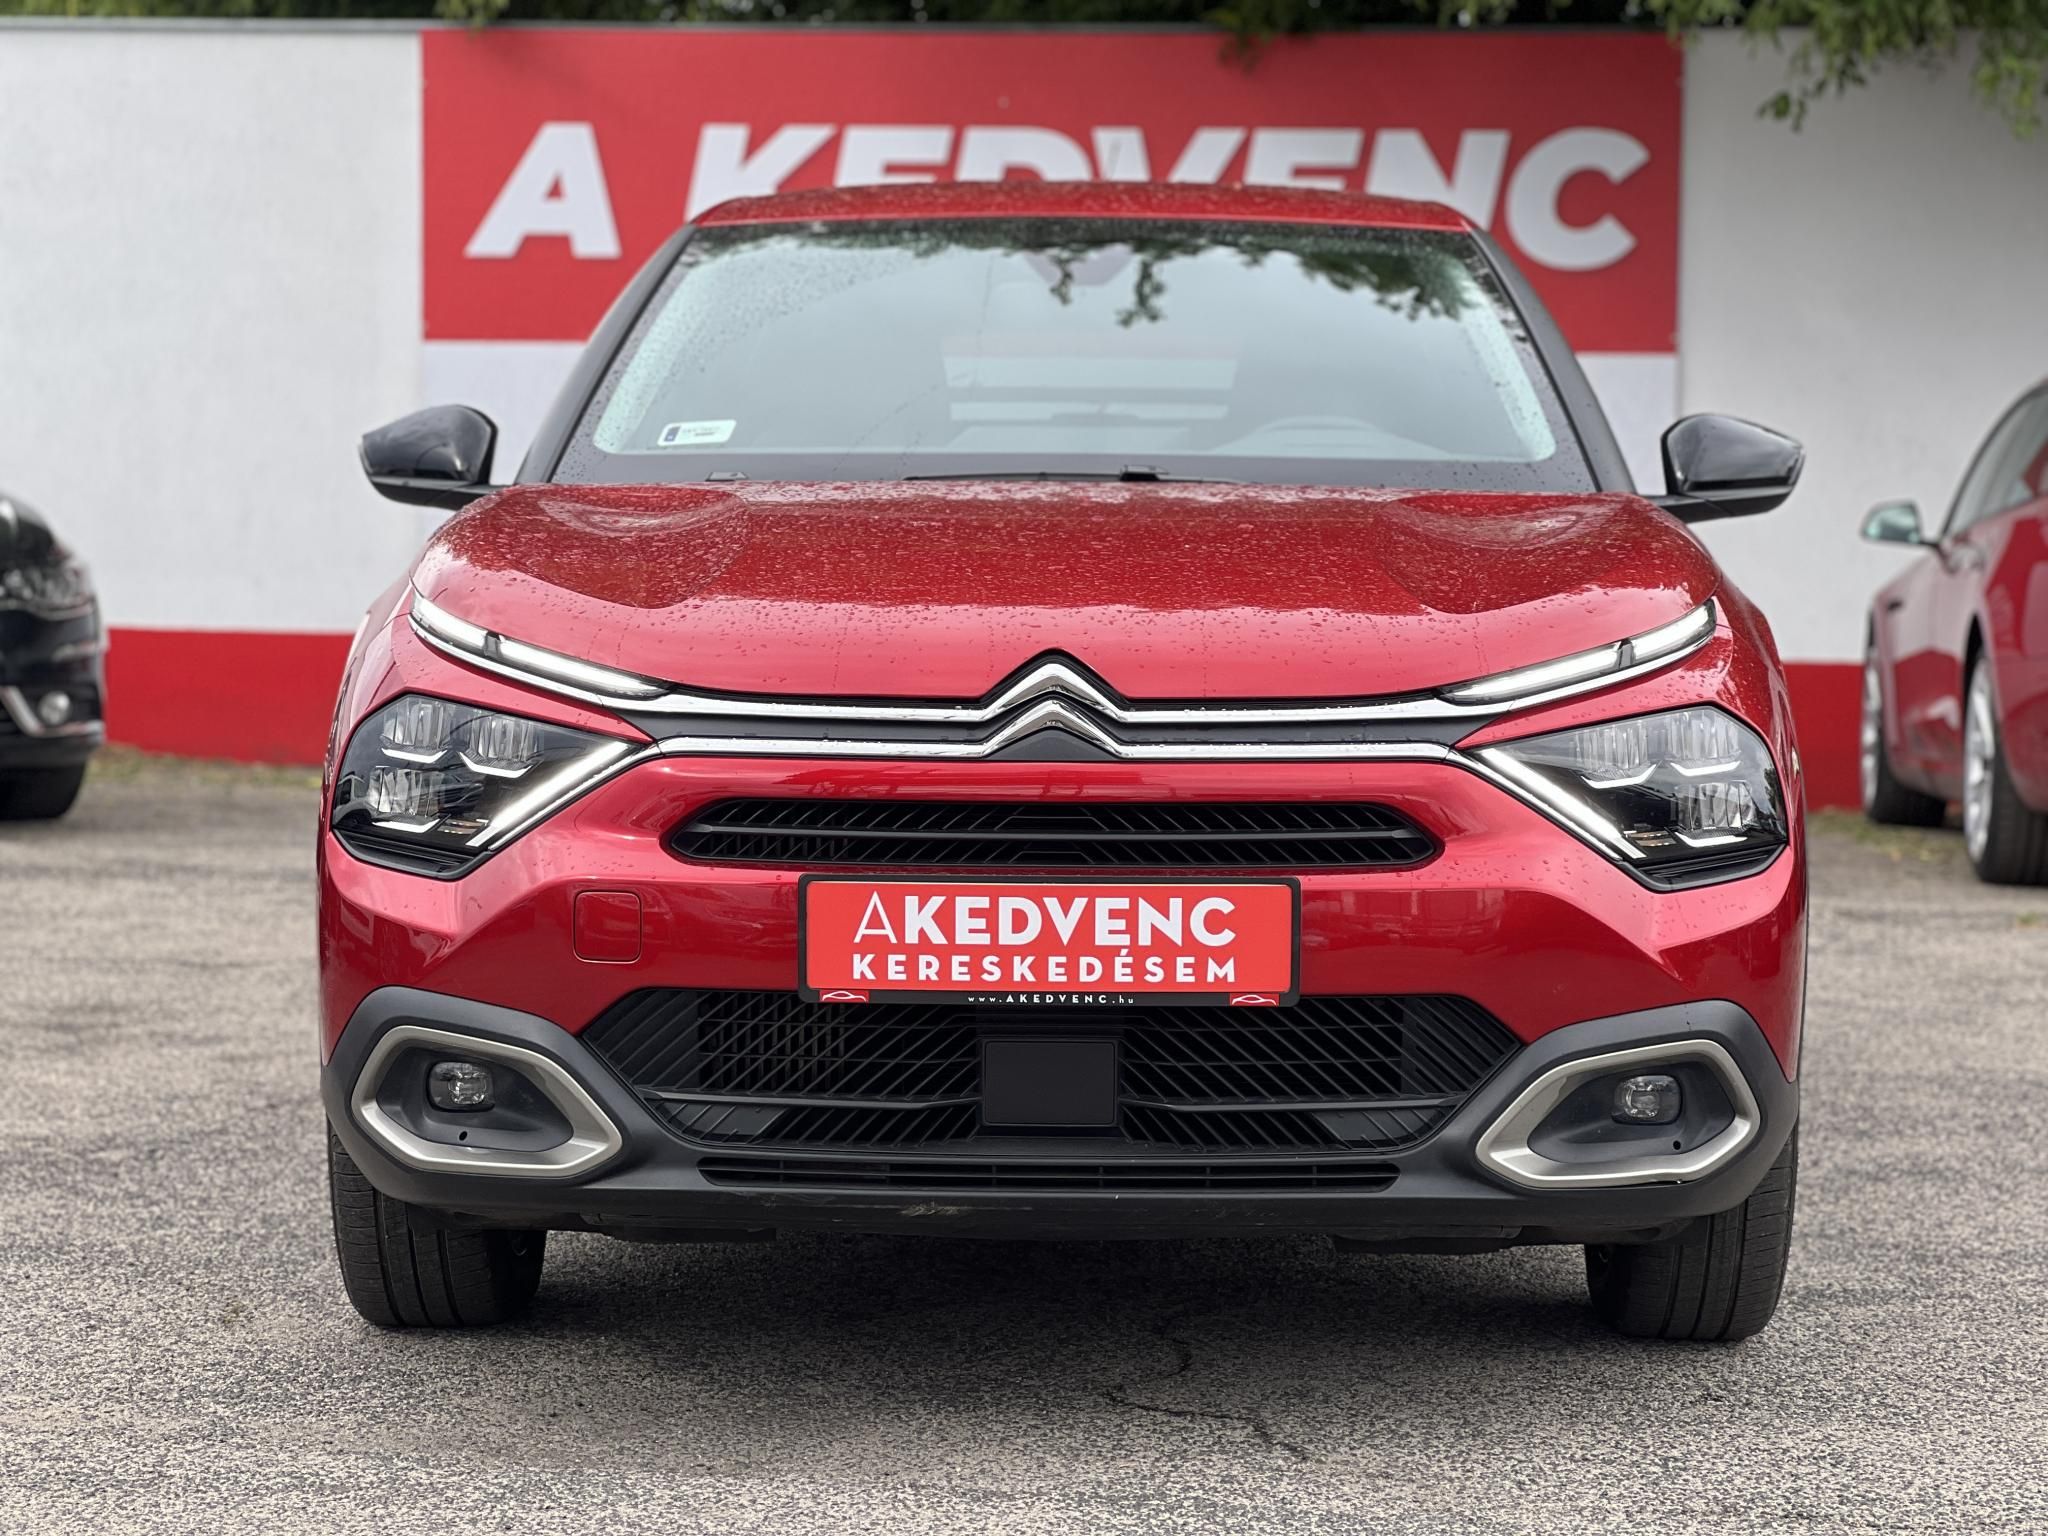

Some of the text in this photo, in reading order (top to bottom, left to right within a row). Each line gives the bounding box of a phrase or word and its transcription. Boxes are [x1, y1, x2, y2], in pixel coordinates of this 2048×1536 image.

[463, 120, 623, 260] A
[852, 948, 1236, 983] KERESKEDÉSEM
[967, 993, 1134, 1005] www.AKEDVENC.hu
